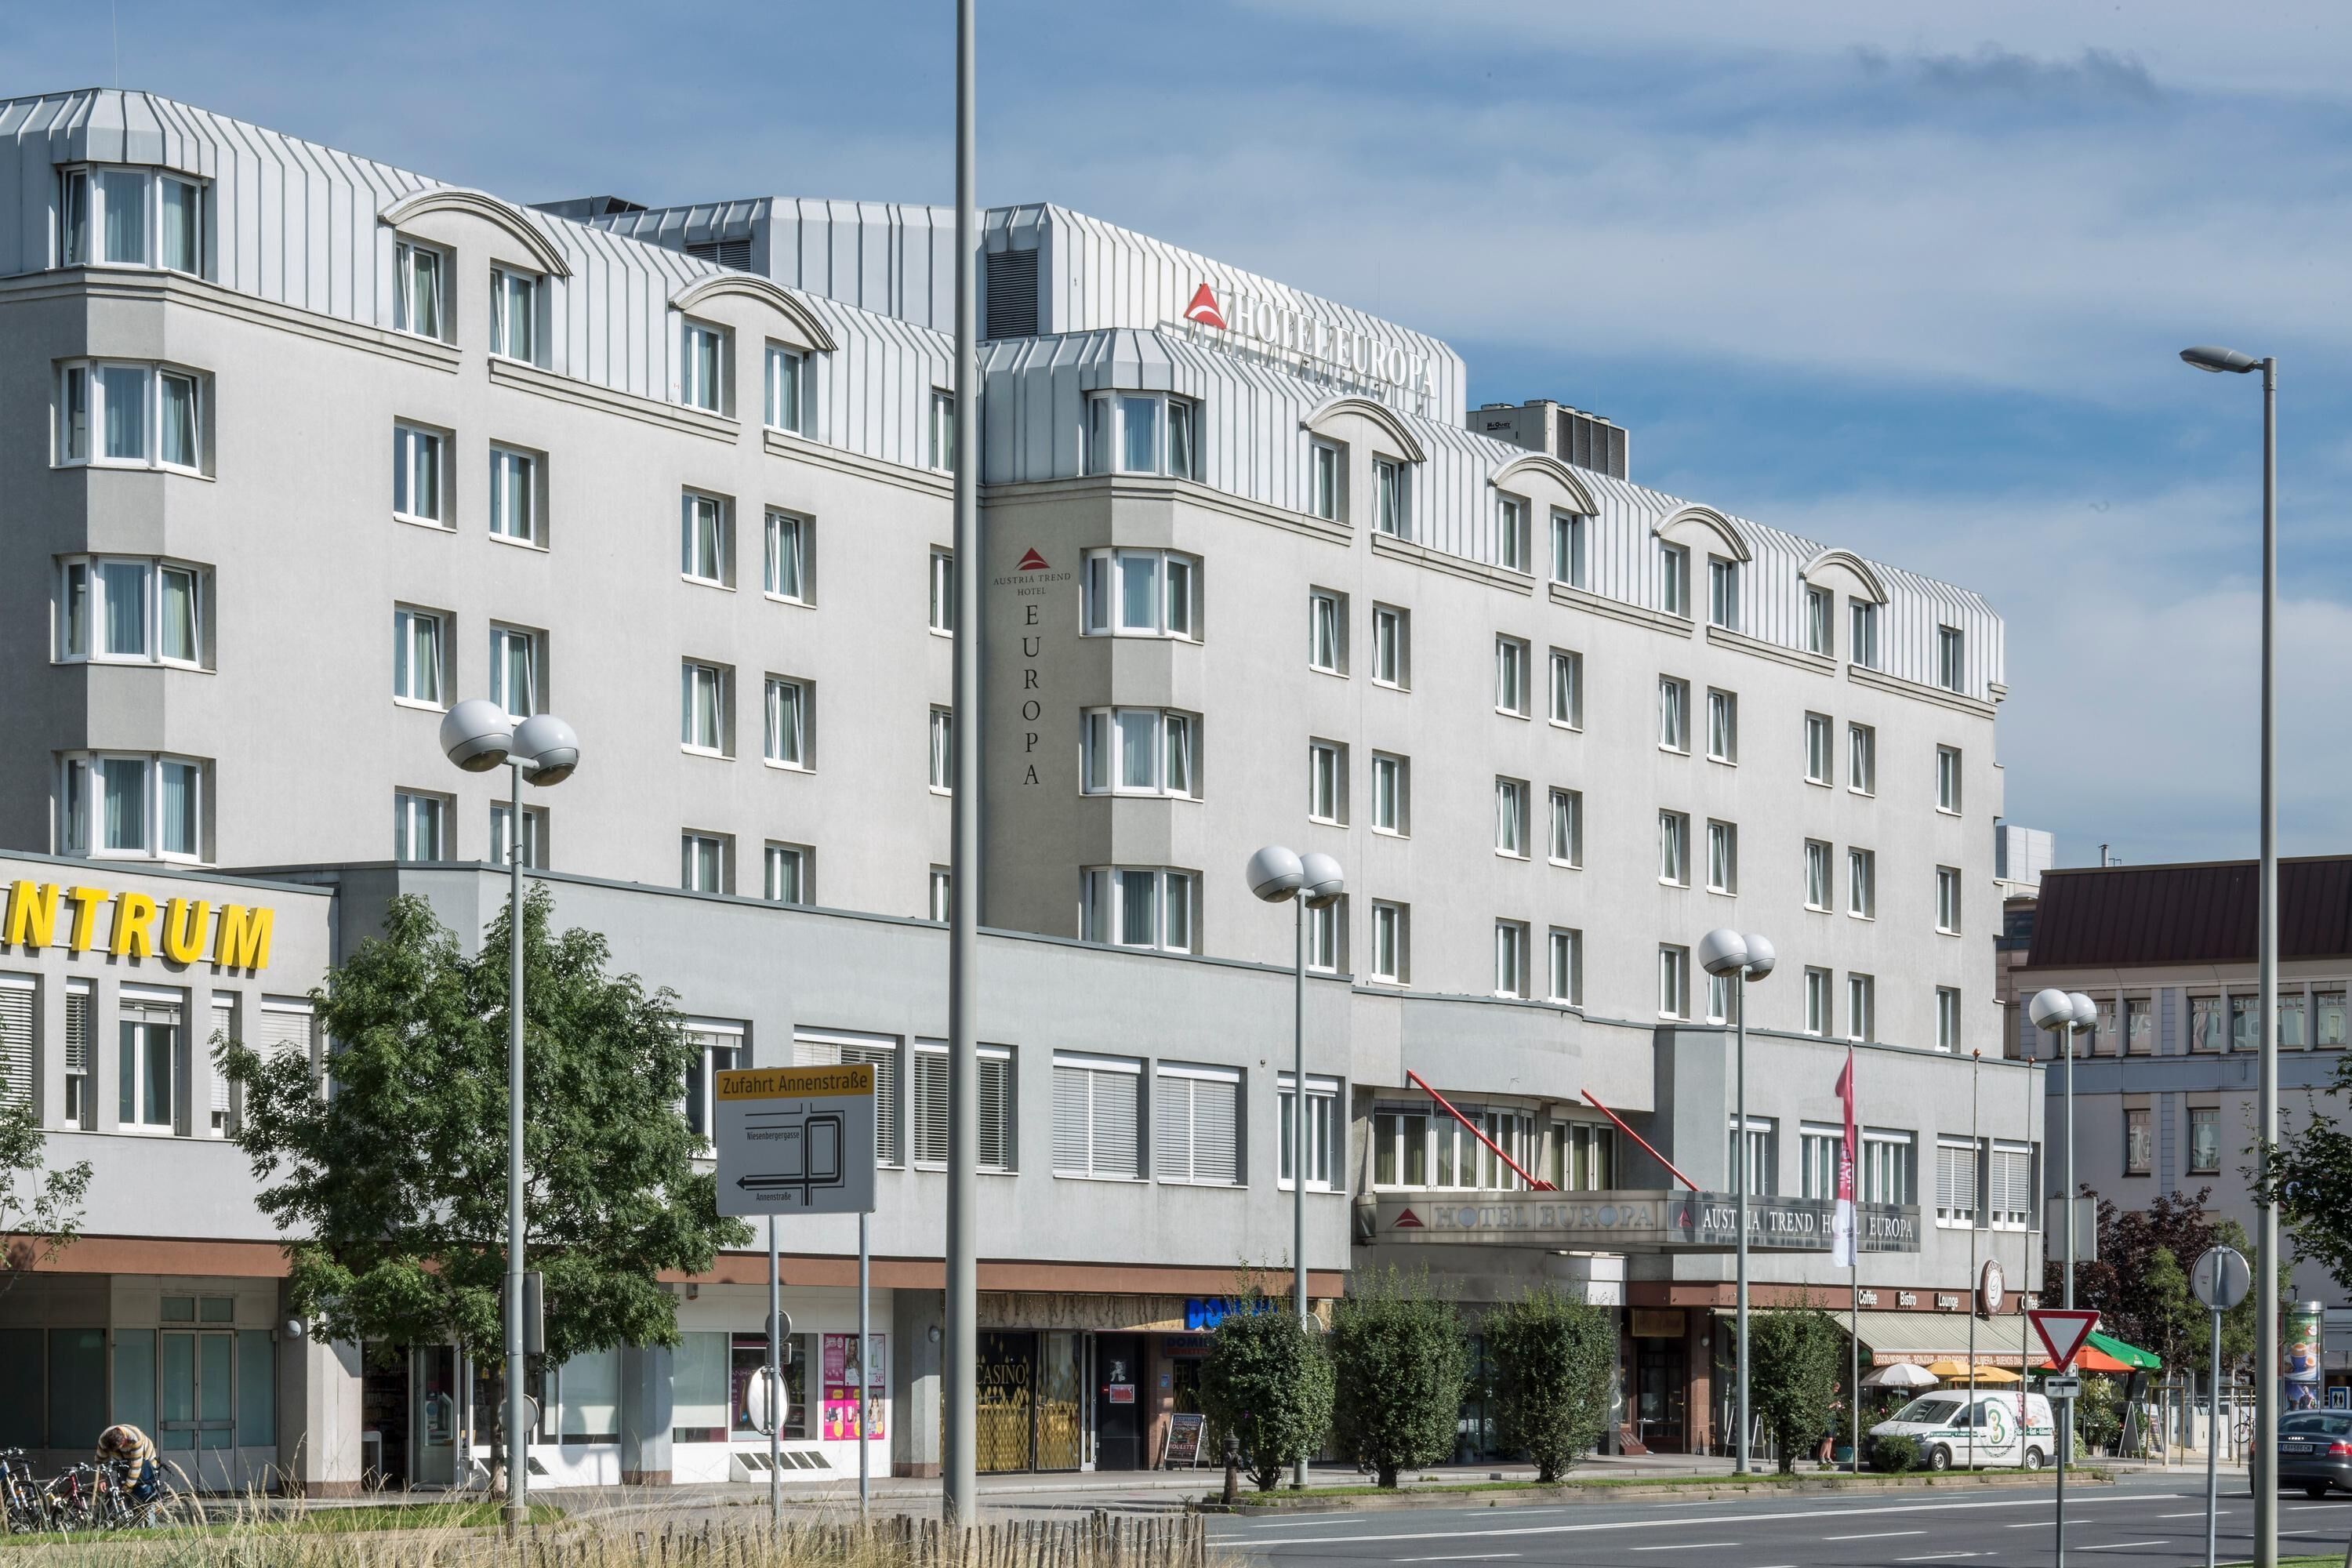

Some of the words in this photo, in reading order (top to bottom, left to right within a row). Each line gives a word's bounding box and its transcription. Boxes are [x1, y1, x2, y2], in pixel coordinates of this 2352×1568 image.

[1232, 293, 1332, 361] HOTEL
[1332, 325, 1437, 399] EUROPA
[993, 575, 1034, 586] AUSTRIA
[1038, 572, 1071, 583] TREND
[1017, 587, 1047, 596] HOTEL
[1022, 604, 1041, 785] EUROPA
[5, 880, 275, 970] NTRUM
[723, 1077, 774, 1094] Zufahrt
[779, 1071, 867, 1091] Annenstraße
[746, 1131, 800, 1142] Niesenbergergasse
[756, 1192, 792, 1201] Annenstraße
[1434, 1206, 1528, 1228] HOTEL
[1540, 1206, 1654, 1227] EUROPA
[1703, 1208, 1760, 1230] AUSTIA
[1769, 1212, 1813, 1232] TREND
[1869, 1217, 1912, 1238] EUROPA
[1858, 1290, 1878, 1305] Coffee
[1900, 1290, 1917, 1306] Bistro
[1938, 1292, 1958, 1311] Lounge
[976, 1364, 1025, 1385] CASINO
